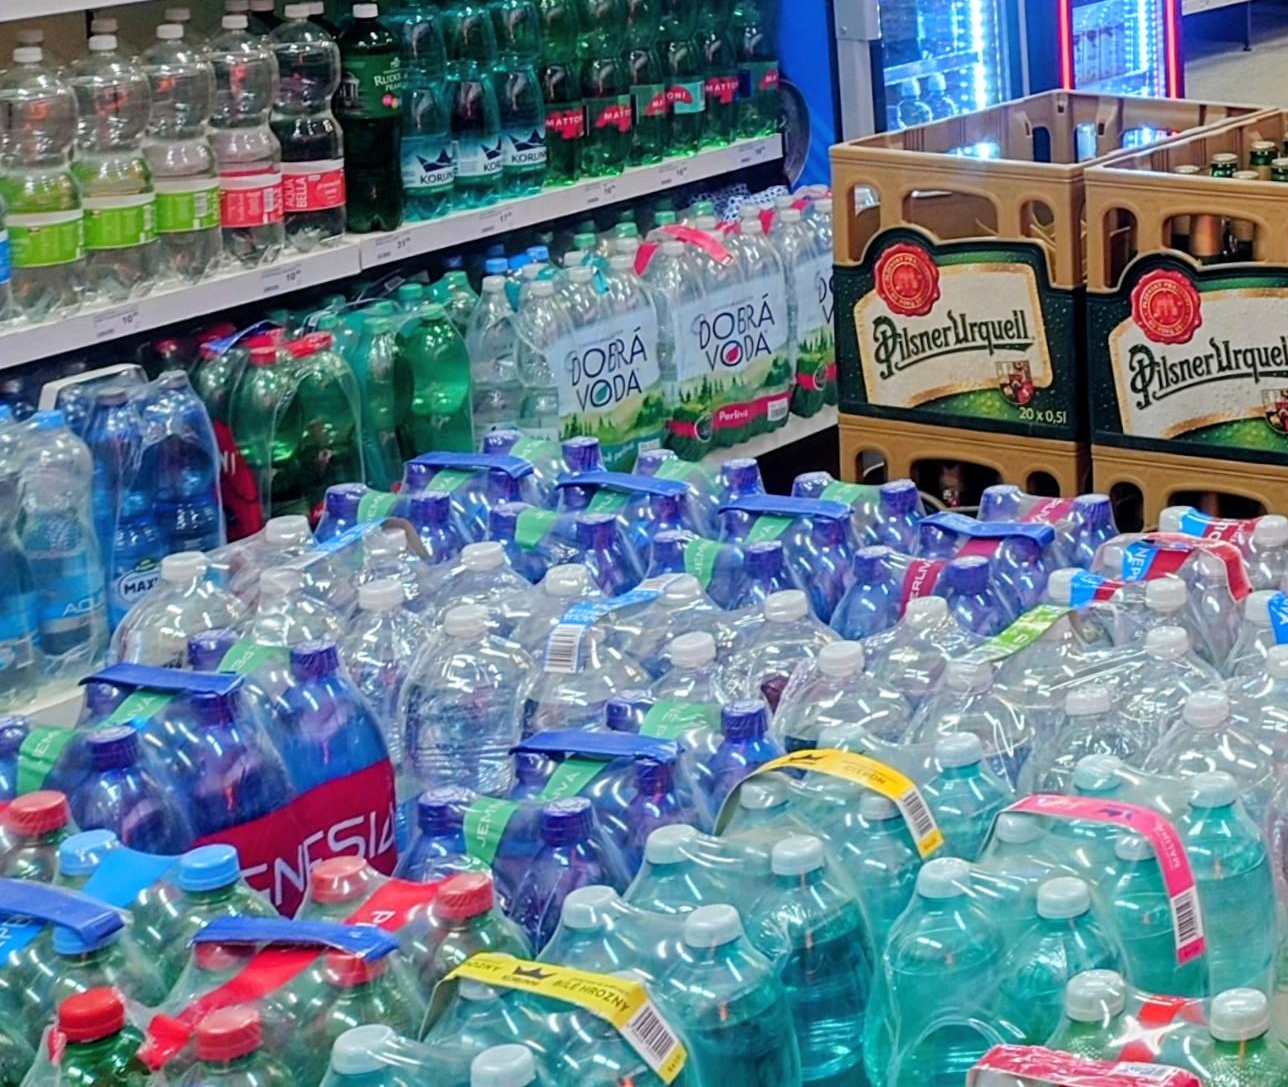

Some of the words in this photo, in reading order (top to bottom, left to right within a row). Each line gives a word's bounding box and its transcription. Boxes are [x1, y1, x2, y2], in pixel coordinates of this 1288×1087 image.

[706, 334, 772, 368] VODA
[872, 316, 952, 380] Pilsner
[948, 308, 1036, 354] Urquell
[576, 372, 643, 412] VODA
[1127, 343, 1215, 411] Pilsner
[1019, 406, 1035, 421] 20
[1037, 411, 1046, 422] x
